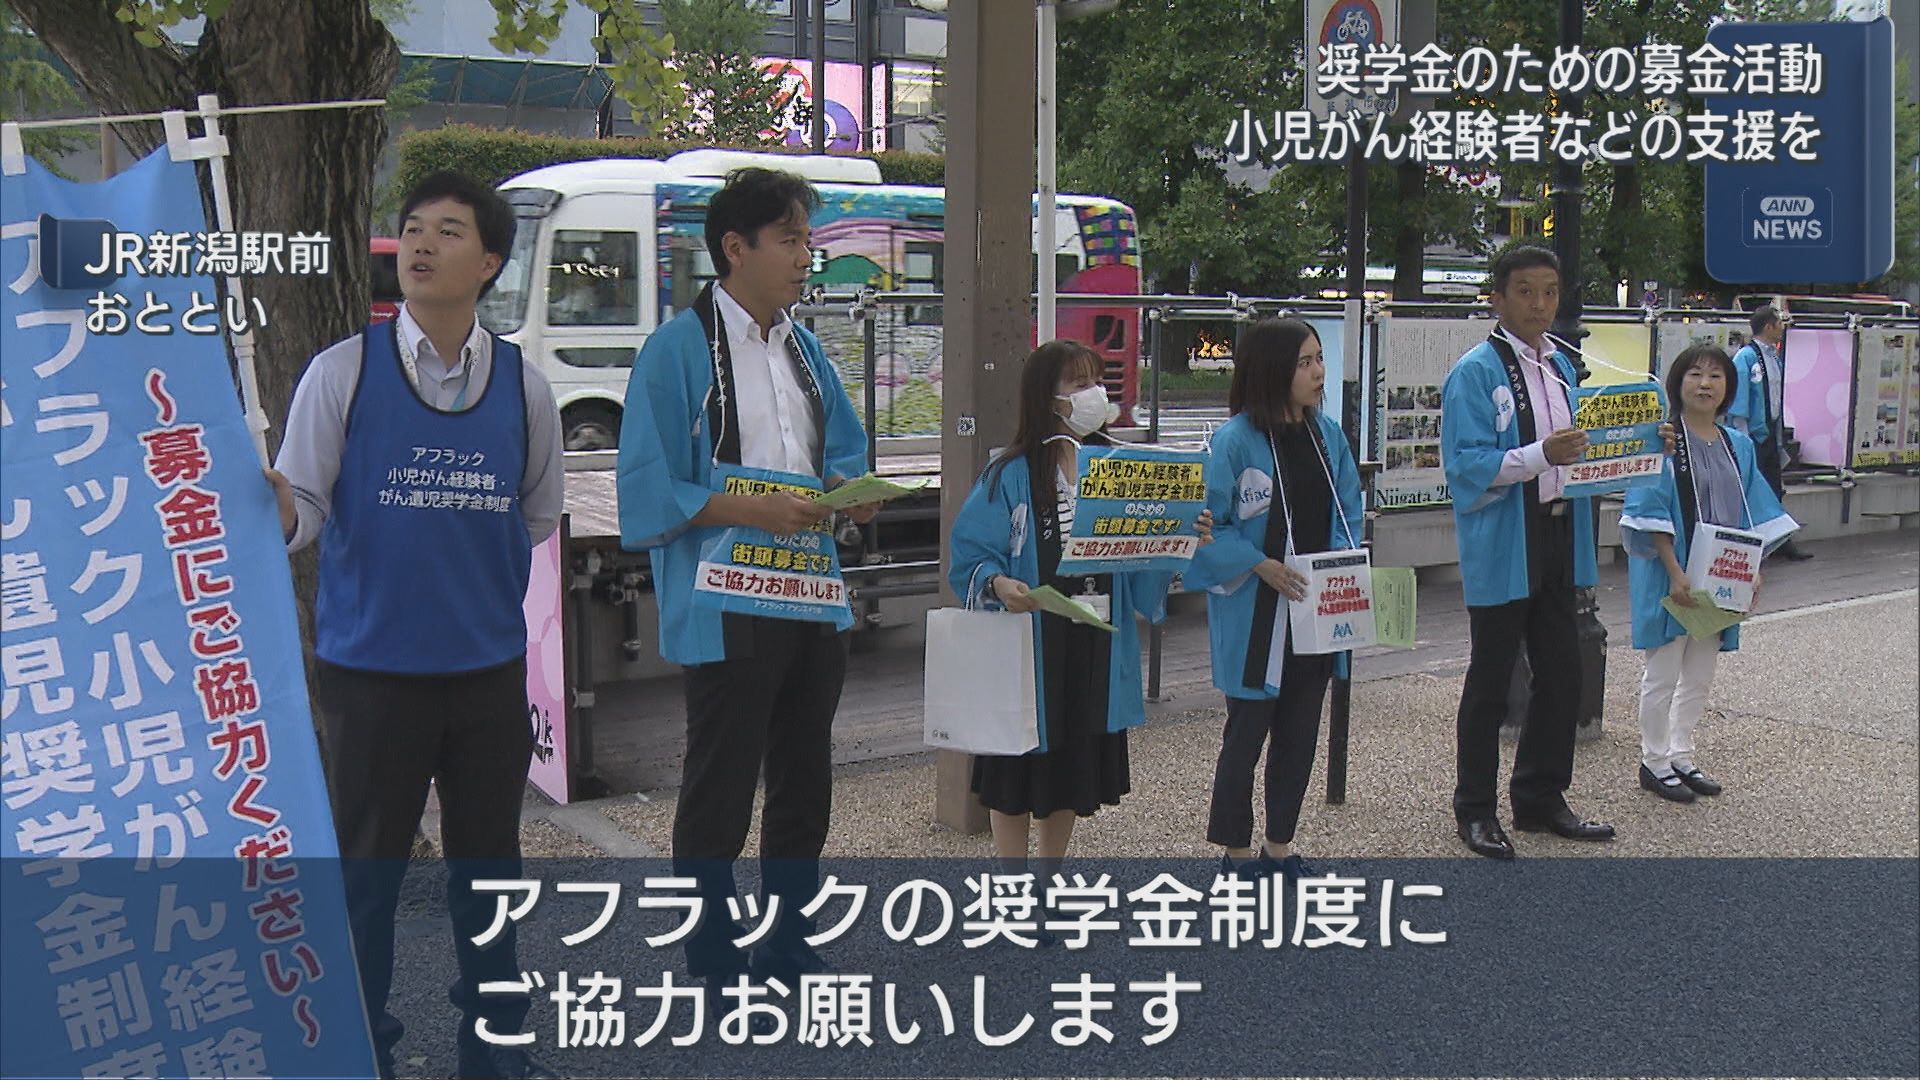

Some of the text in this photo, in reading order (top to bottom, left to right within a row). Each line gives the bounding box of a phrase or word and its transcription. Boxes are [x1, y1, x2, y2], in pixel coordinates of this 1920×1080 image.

[411, 447, 486, 466] アフラック
[378, 489, 512, 513] がん遺児奨学金制度
[1376, 487, 1431, 507] Niigata
